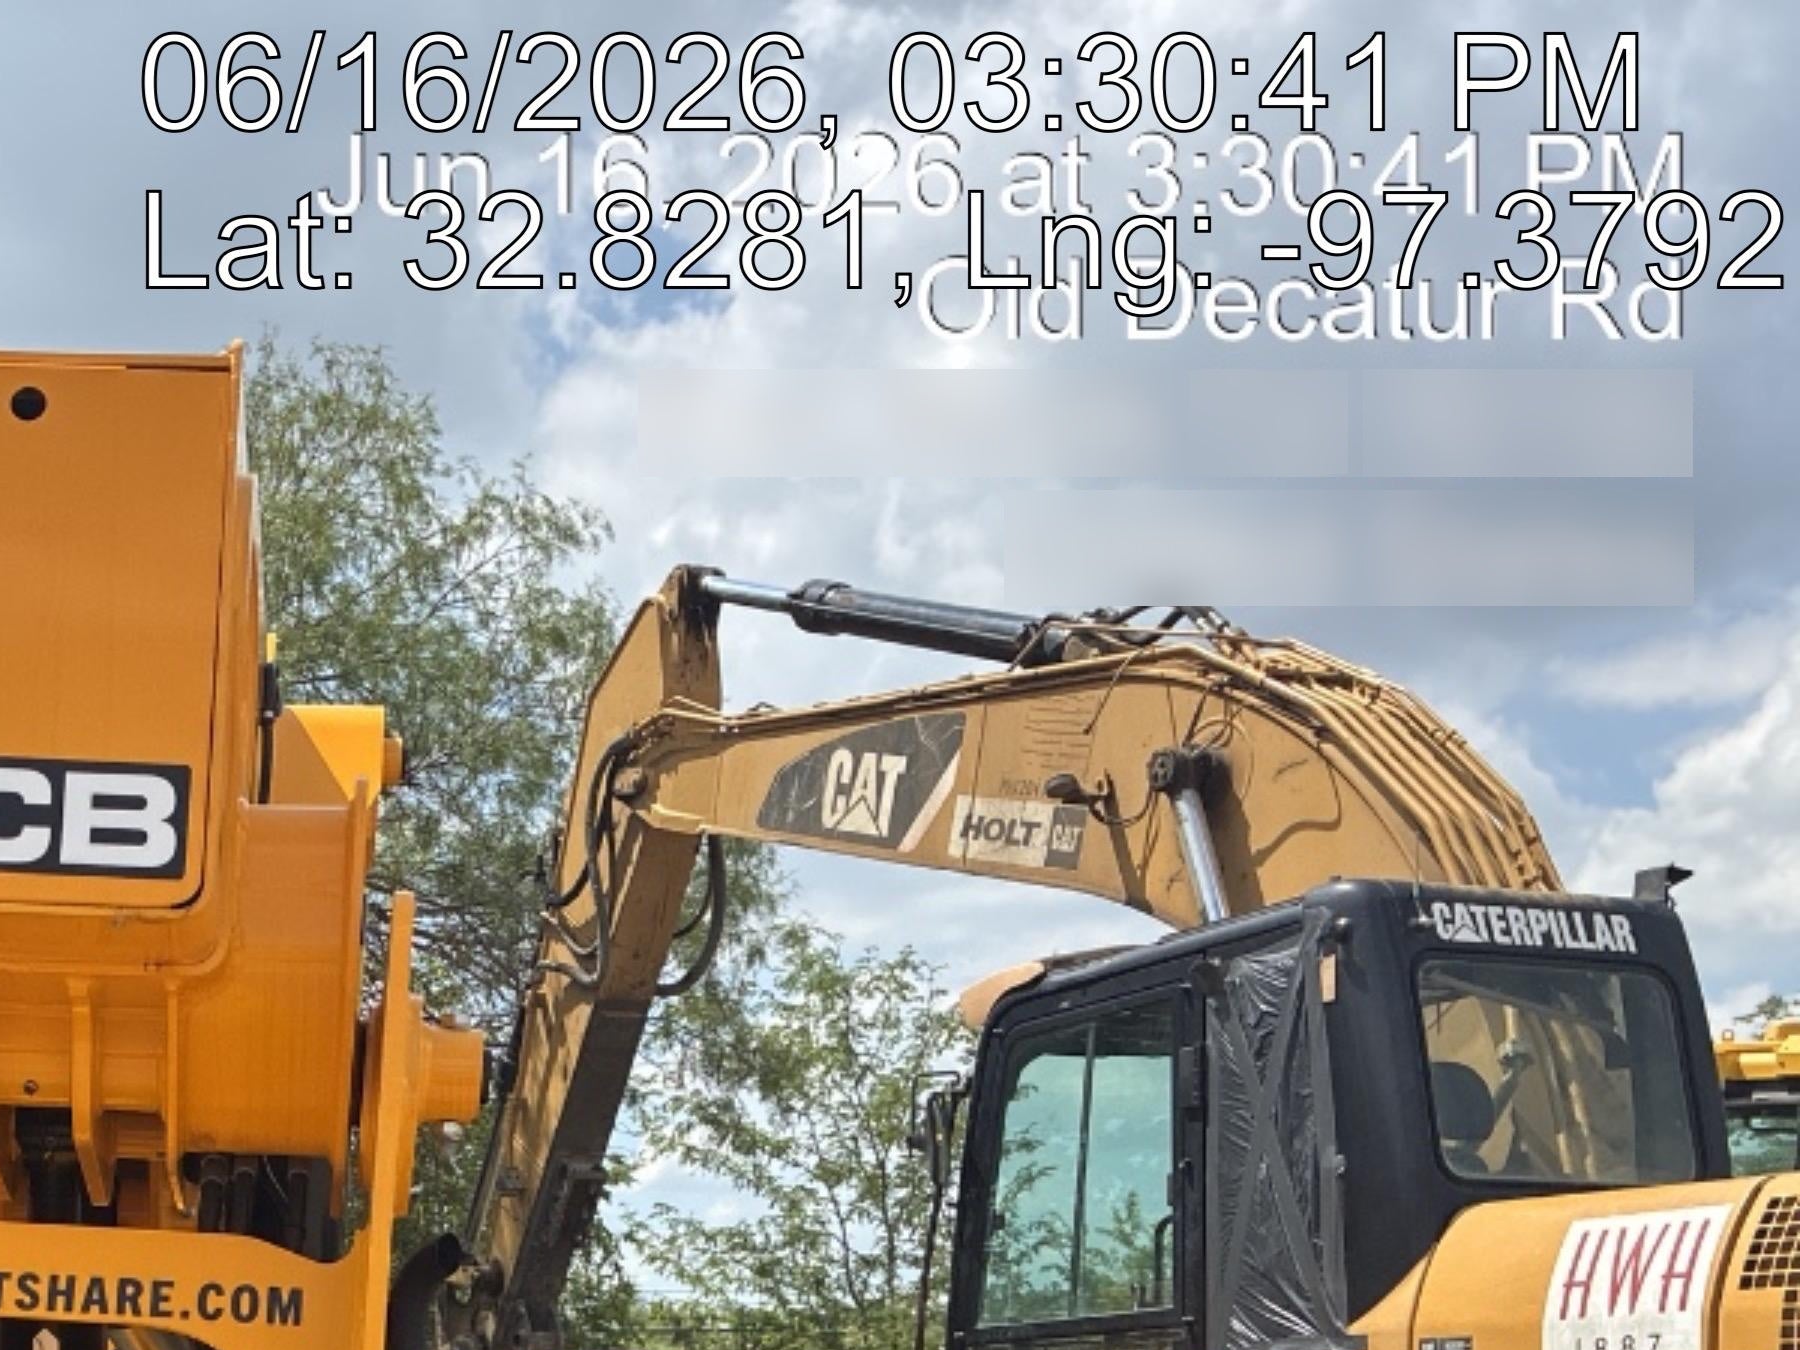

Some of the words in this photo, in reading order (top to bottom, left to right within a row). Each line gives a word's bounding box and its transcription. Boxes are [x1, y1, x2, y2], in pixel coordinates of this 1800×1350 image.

[821, 747, 907, 838] CAT
[960, 812, 1041, 847] HOLT
[1431, 901, 1638, 953] CATERPILLAR
[1559, 1217, 1711, 1320] HWH
